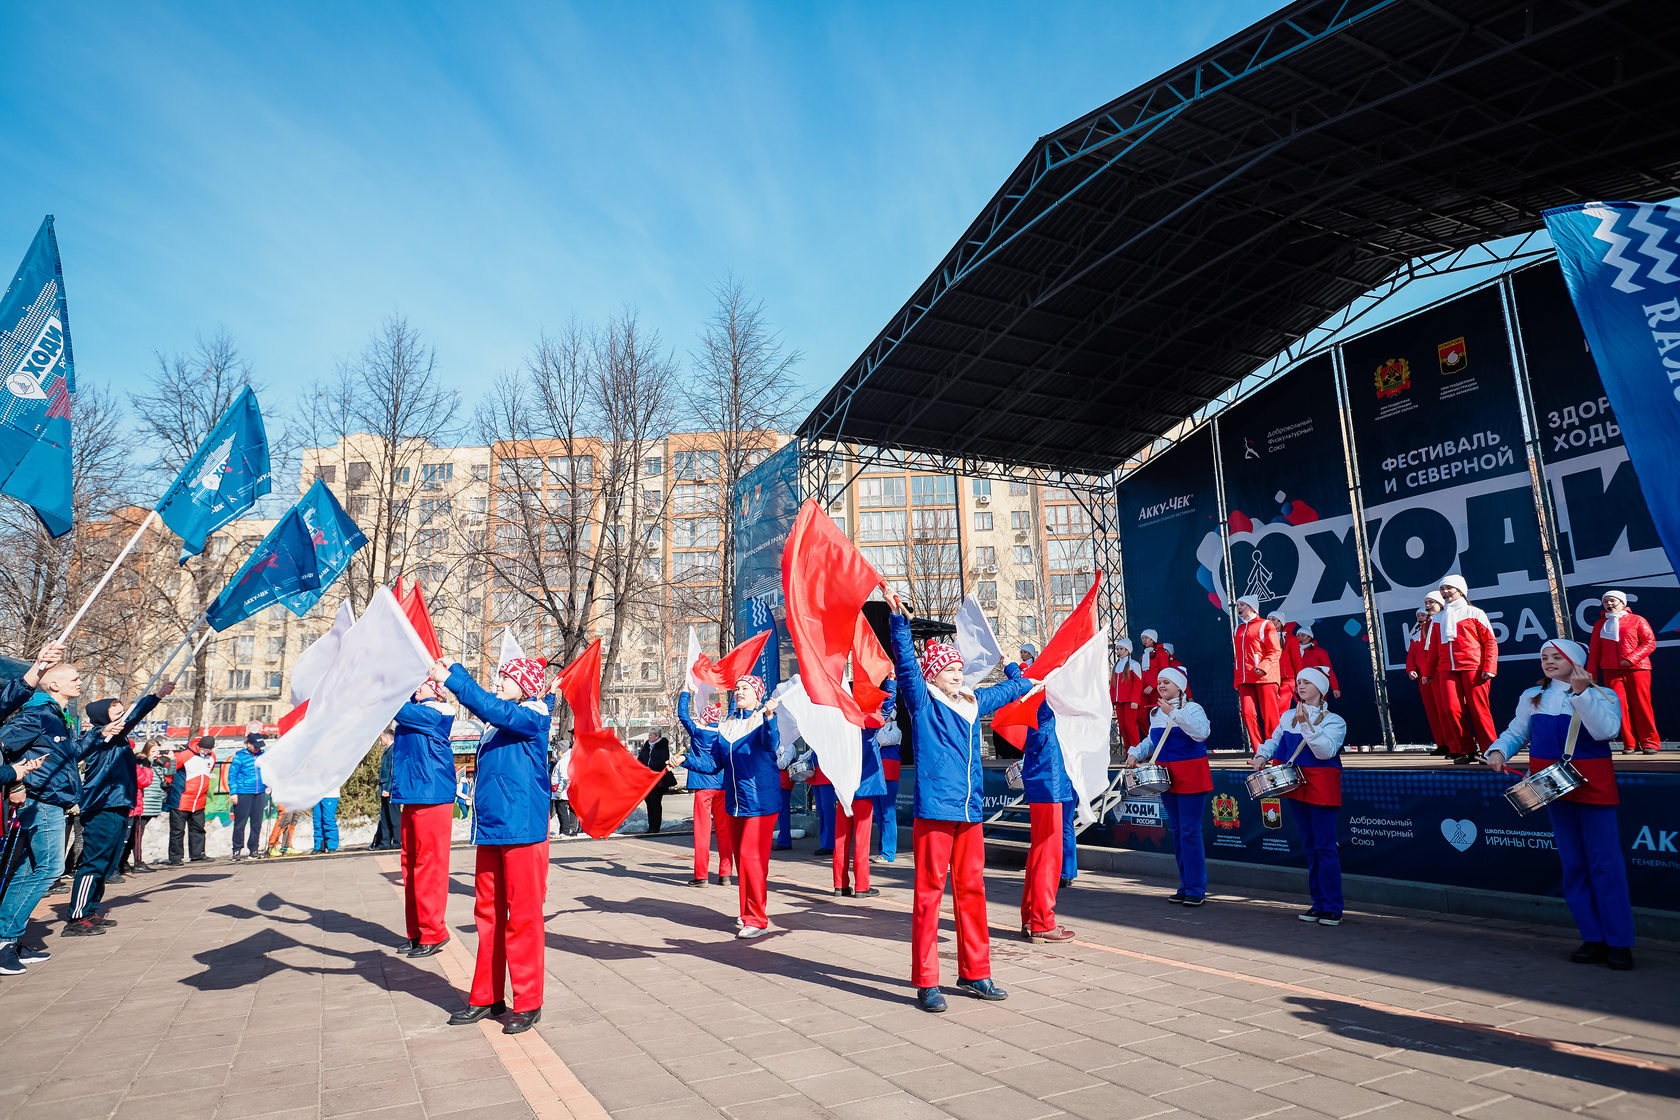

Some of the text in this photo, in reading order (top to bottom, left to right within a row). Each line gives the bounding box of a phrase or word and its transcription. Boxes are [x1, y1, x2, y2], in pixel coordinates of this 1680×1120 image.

[21, 325, 62, 379] ХОДИ
[1267, 417, 1312, 438] Добровольный
[1268, 443, 1285, 453] Союз
[1381, 430, 1500, 473] ФЕСТИВАЛЬ
[1384, 477, 1398, 495] И
[1405, 445, 1514, 489] СЕВЕРНОЙ
[1304, 459, 1664, 604] ХОДИ
[1350, 816, 1412, 826] Добровольный
[1351, 827, 1413, 838] Физкультурный
[1351, 836, 1375, 846] Союз
[1485, 836, 1525, 847] ИРИНЫ
